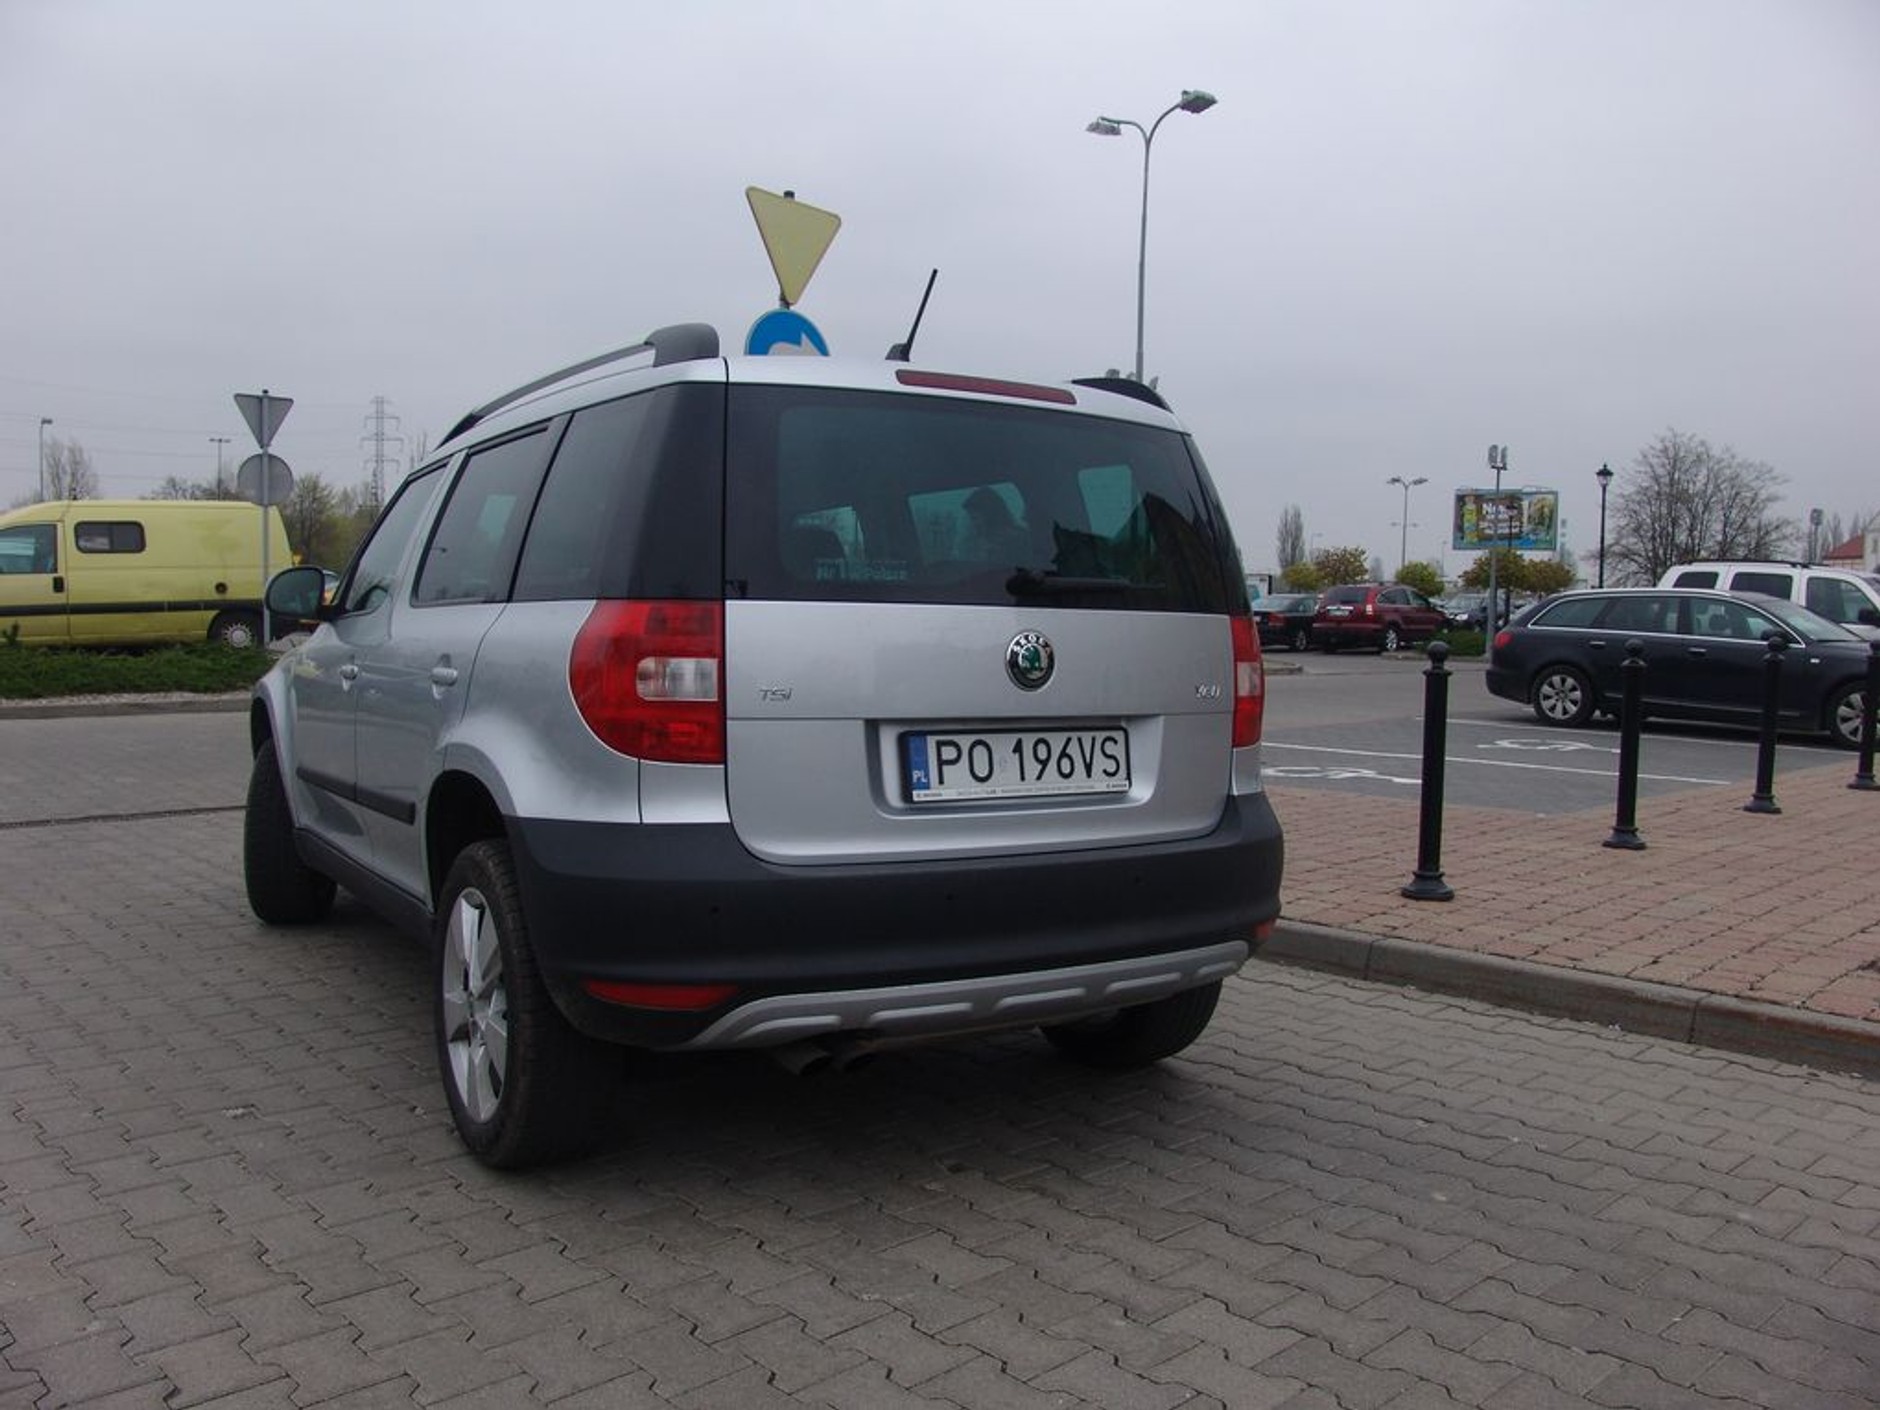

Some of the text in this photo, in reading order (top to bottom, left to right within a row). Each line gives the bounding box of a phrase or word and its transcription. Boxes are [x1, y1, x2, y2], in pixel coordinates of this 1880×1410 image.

[912, 769, 928, 783] PL
[935, 736, 1121, 785] PO 196VS
